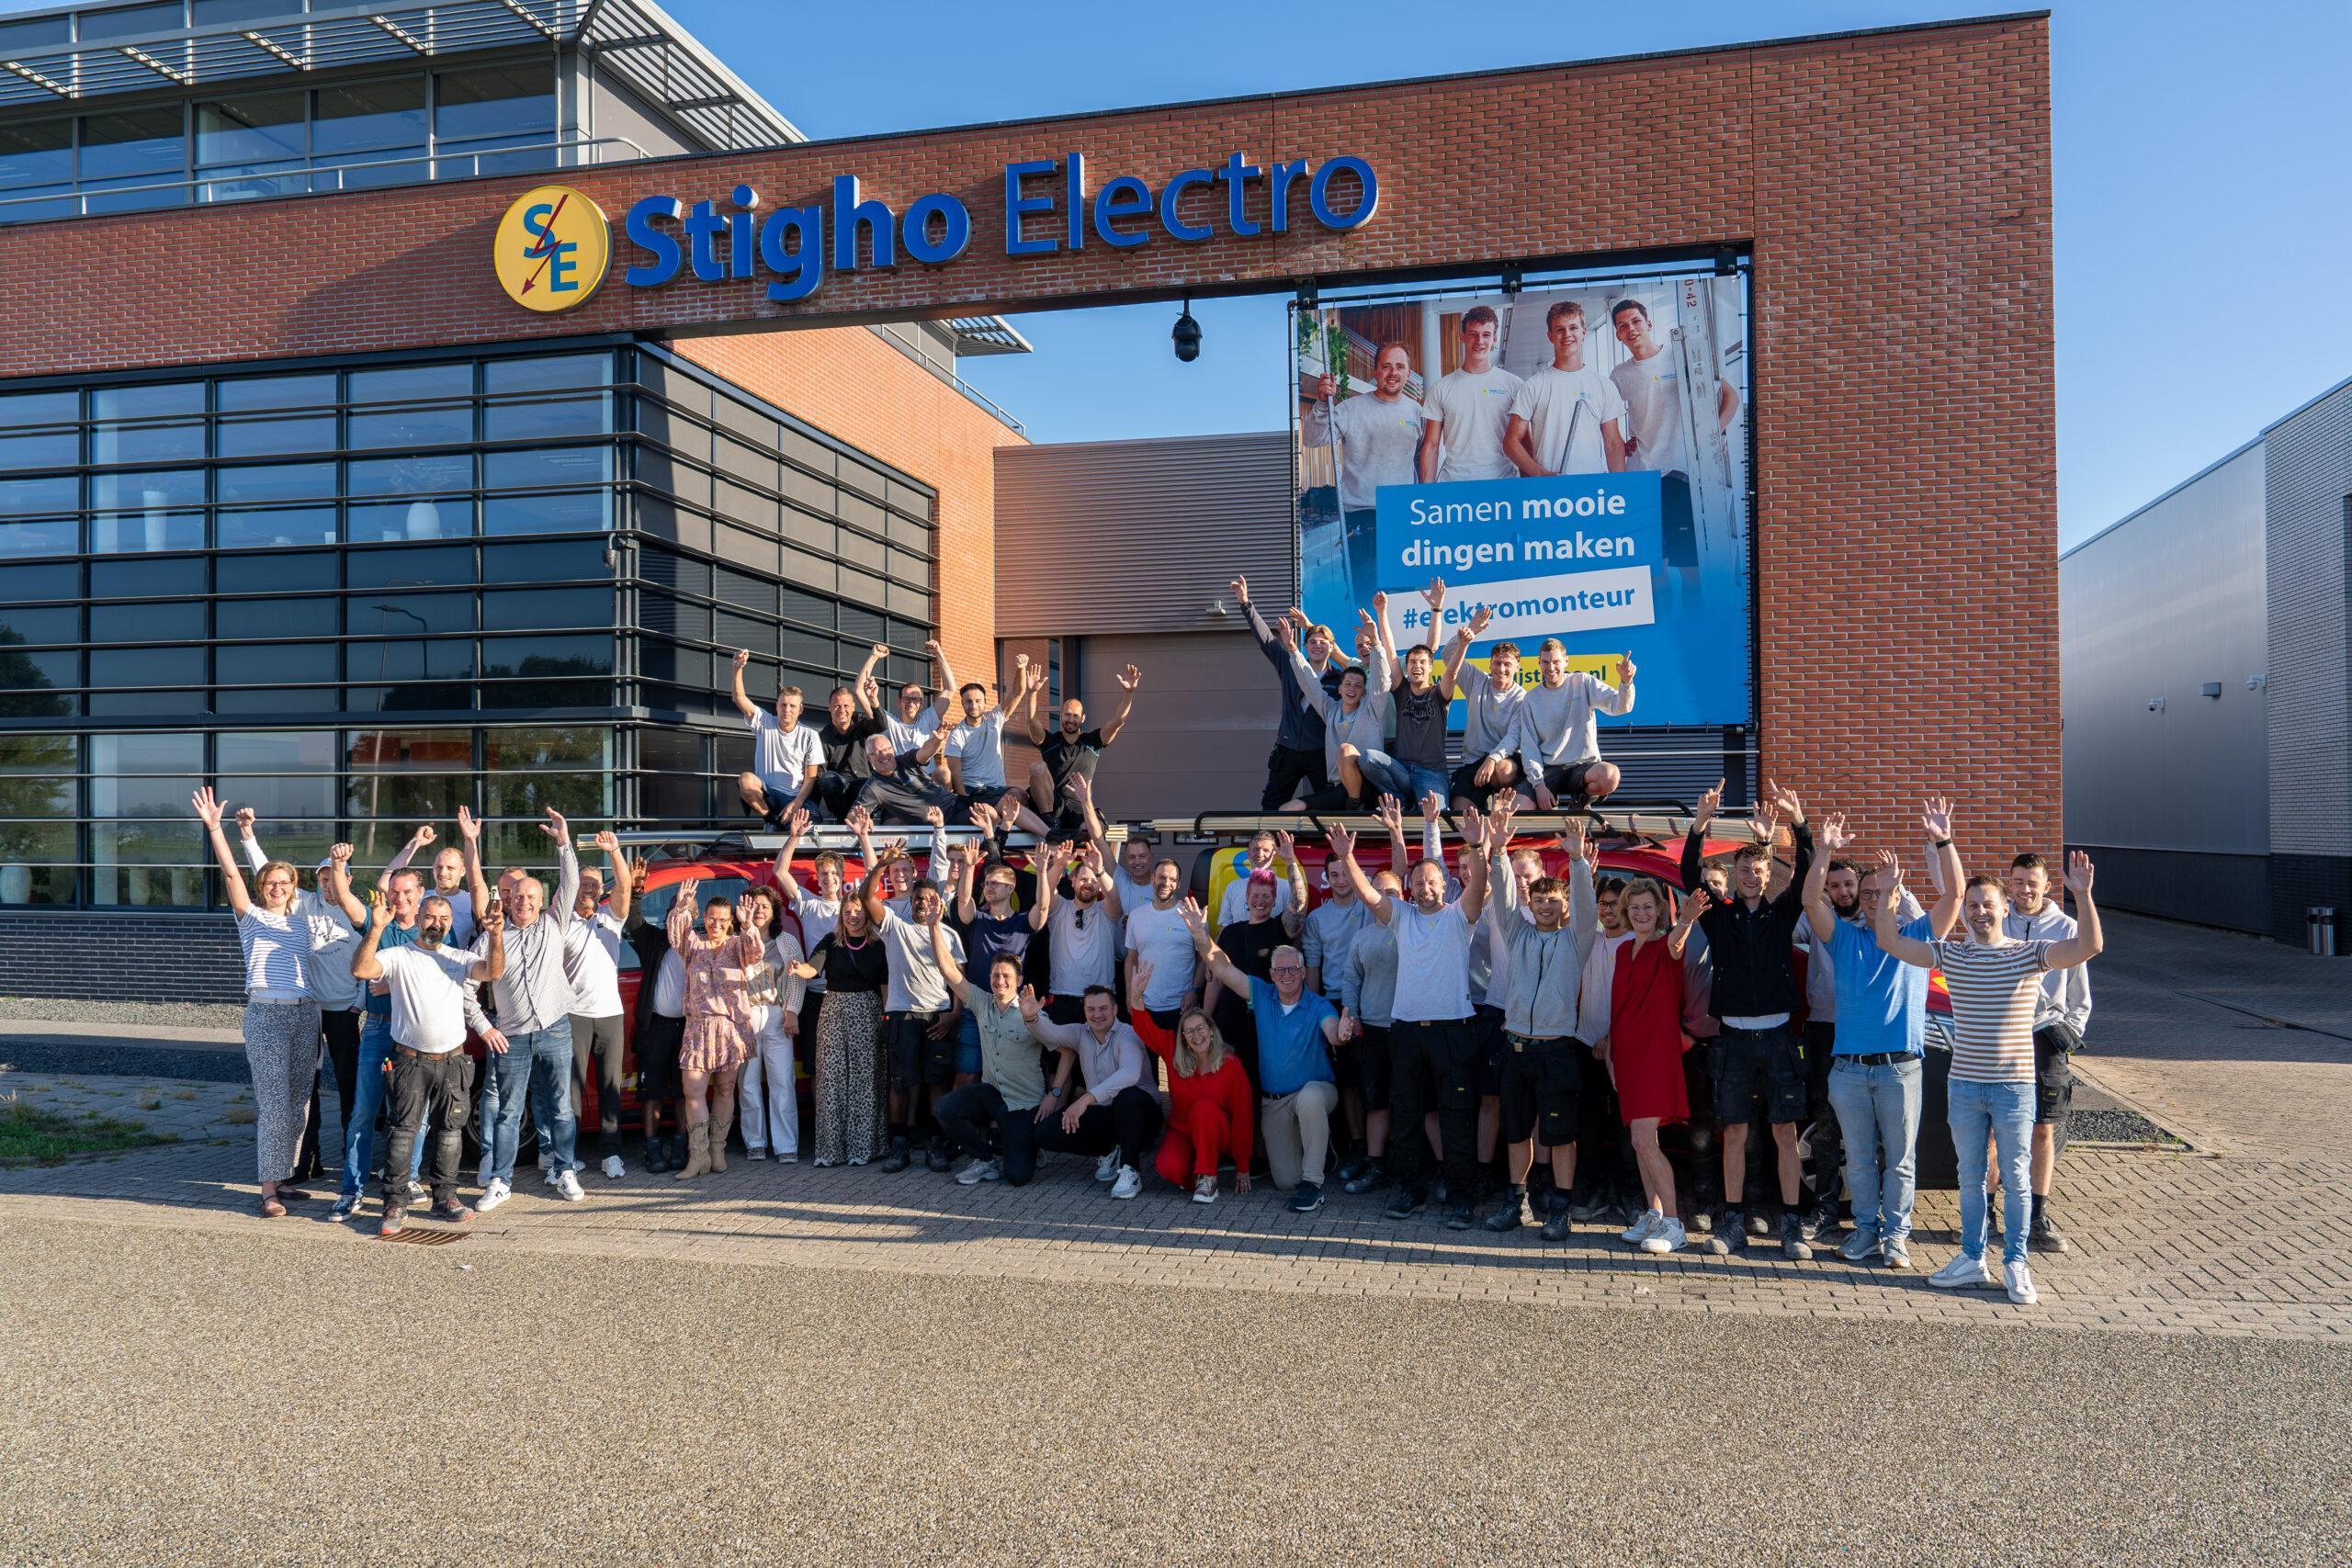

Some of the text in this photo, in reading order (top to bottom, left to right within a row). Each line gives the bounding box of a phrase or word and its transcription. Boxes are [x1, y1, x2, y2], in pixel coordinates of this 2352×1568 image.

[626, 152, 1379, 303] Stigho Electro
[1410, 489, 1626, 526] Samen mooie
[1401, 531, 1635, 571] dingen maken
[1403, 588, 1635, 630] #eektromonteur
